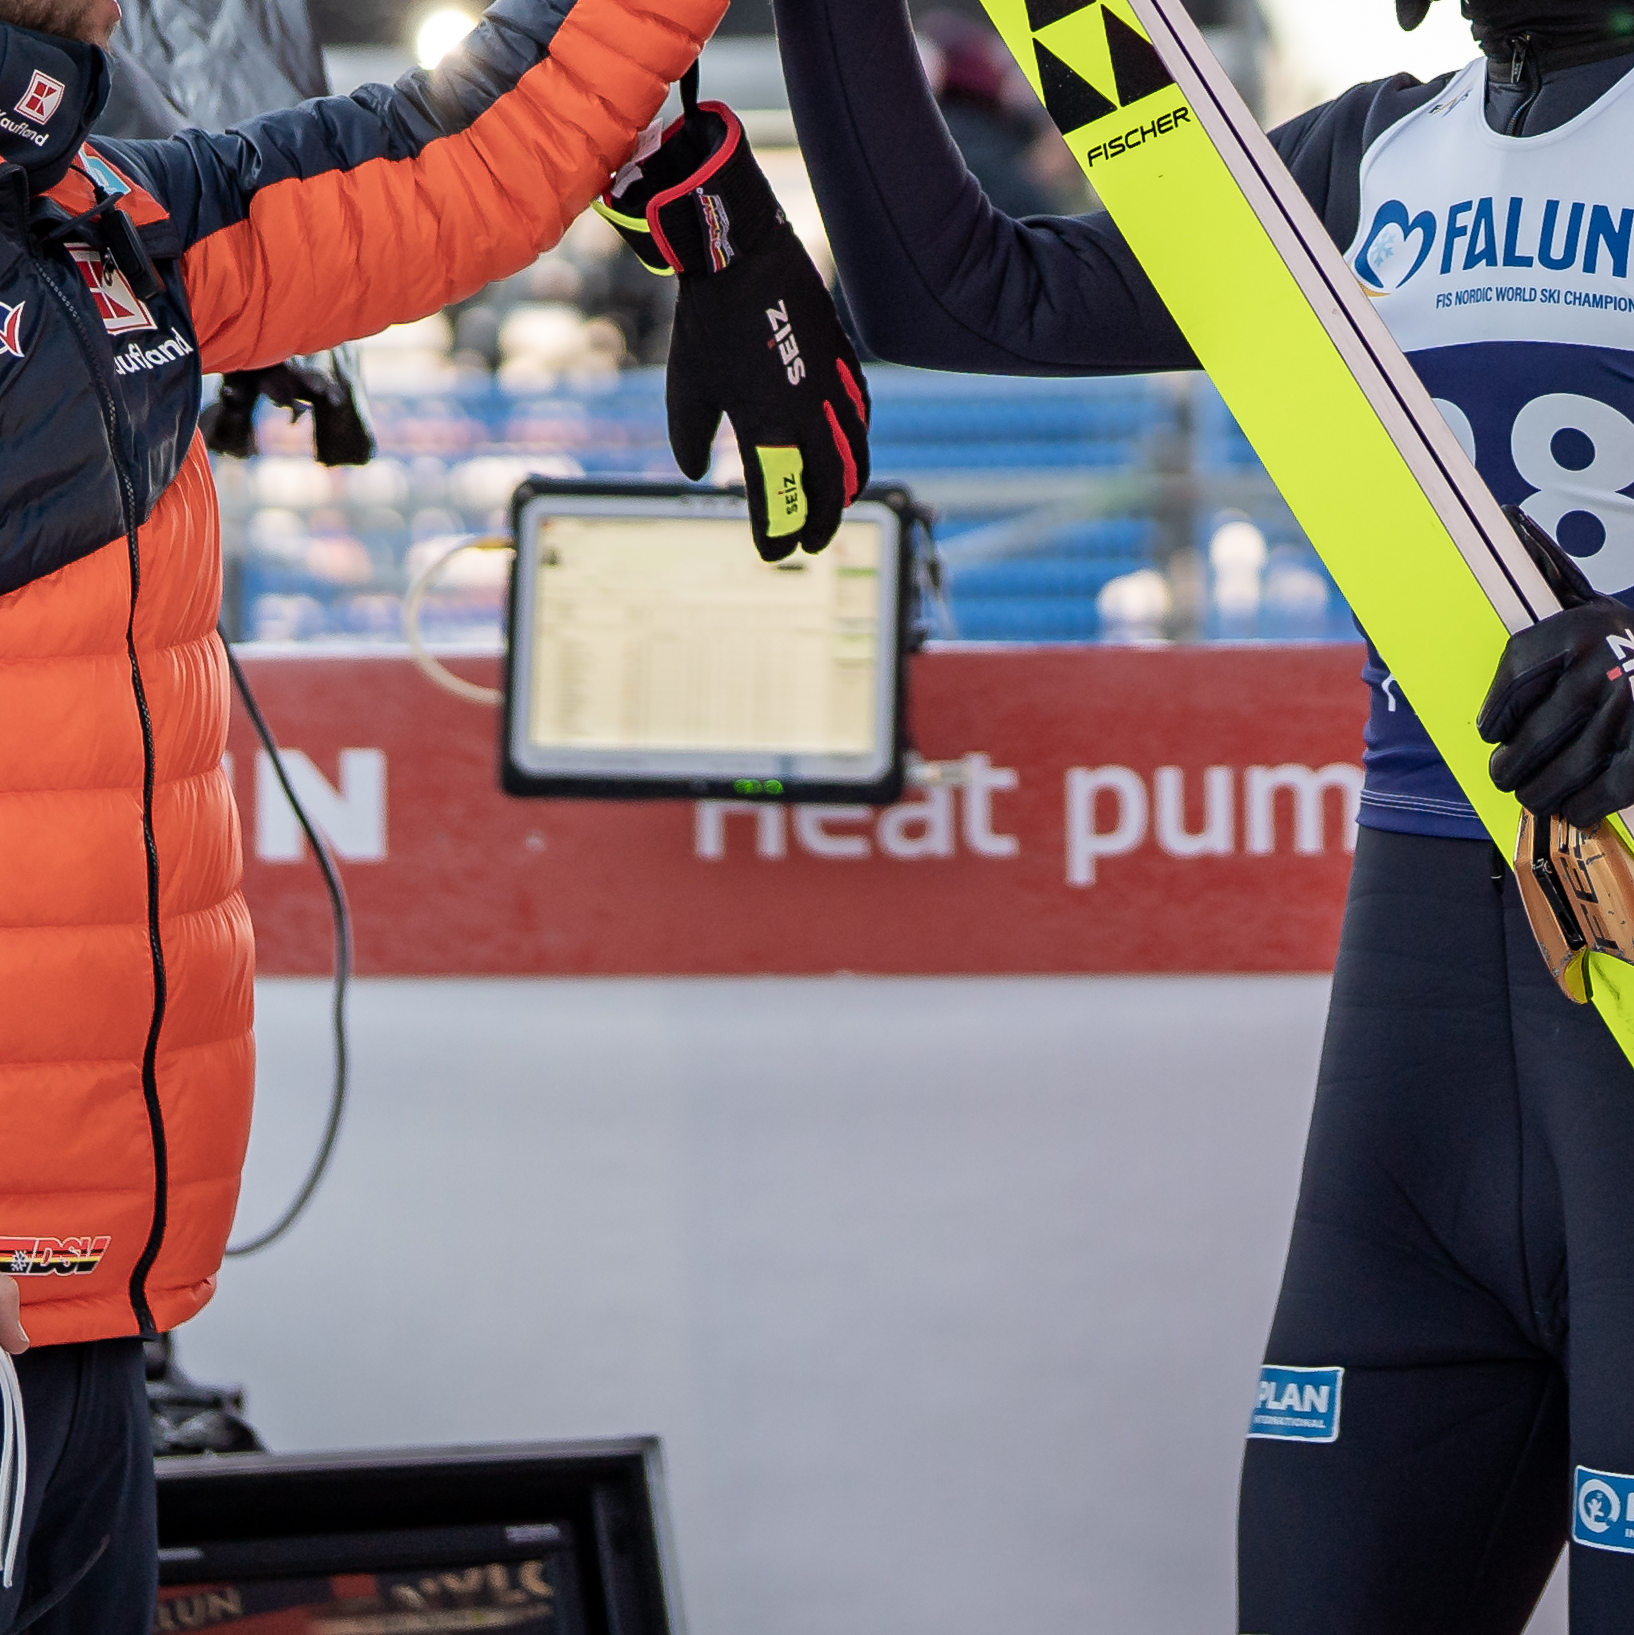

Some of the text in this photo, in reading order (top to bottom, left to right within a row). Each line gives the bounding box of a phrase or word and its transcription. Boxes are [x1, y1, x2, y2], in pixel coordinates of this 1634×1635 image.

[1086, 106, 1191, 168] FISCHER
[1439, 196, 1634, 280] FALUN
[1435, 287, 1453, 309] FIS
[1454, 286, 1493, 307] NORDIC
[1495, 286, 1537, 305] WORLD
[1539, 288, 1561, 305] SKI
[766, 298, 806, 386] SEIZ
